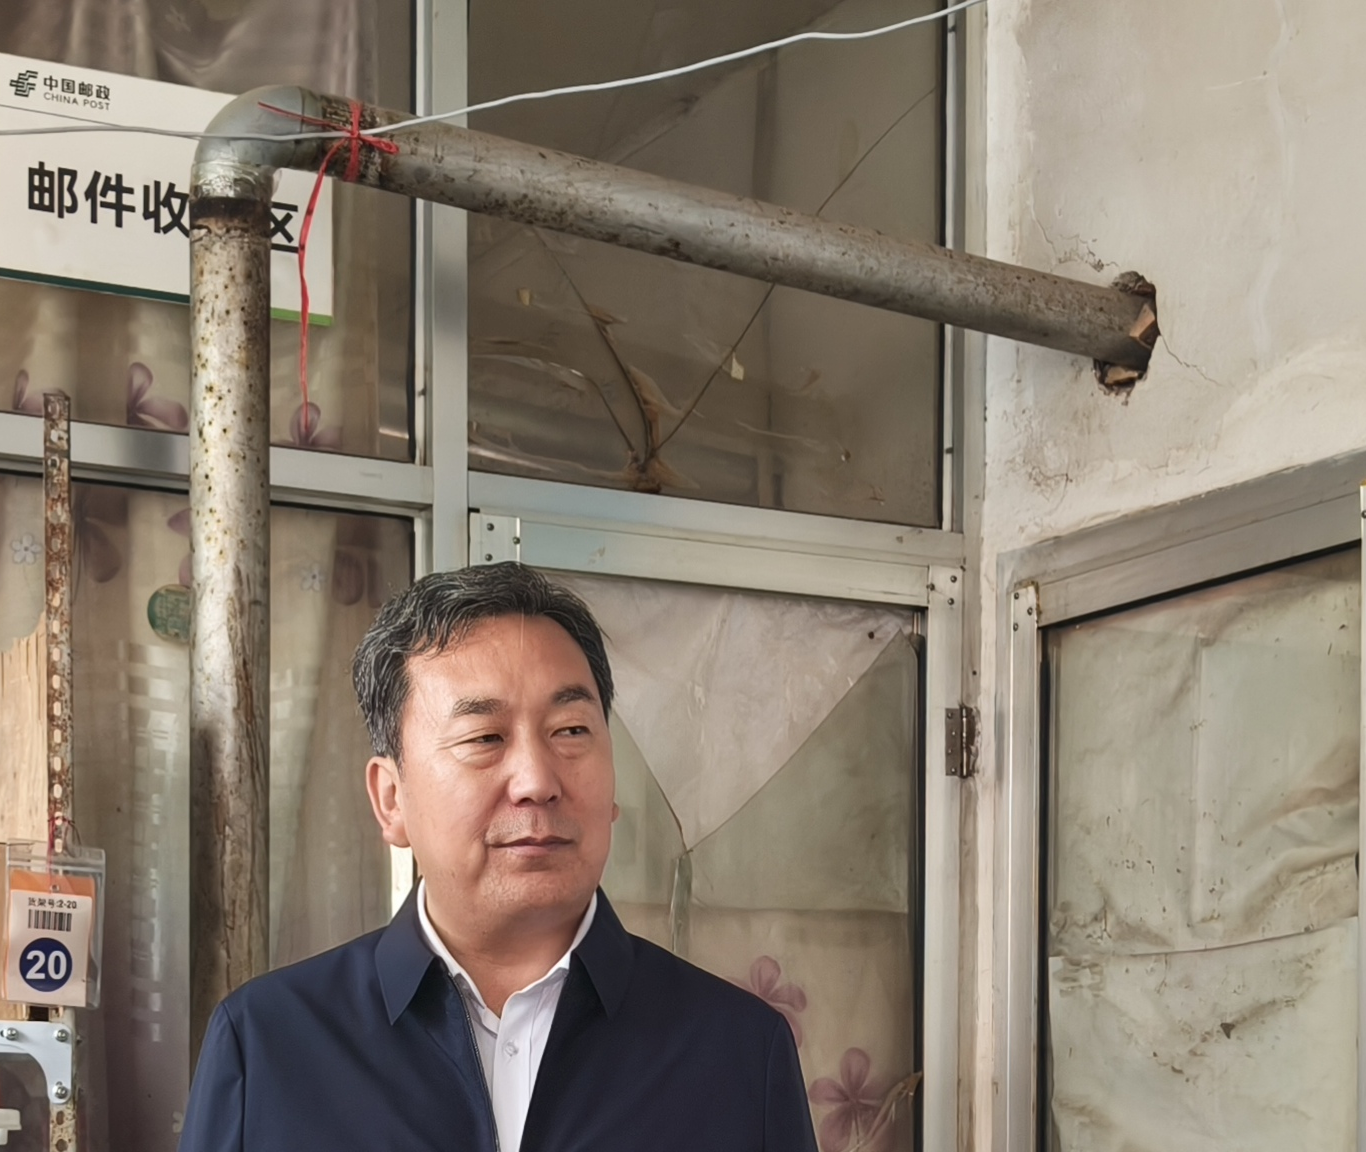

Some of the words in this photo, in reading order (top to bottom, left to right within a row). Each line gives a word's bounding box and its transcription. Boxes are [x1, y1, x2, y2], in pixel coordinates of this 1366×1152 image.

[43, 75, 111, 101] 中国邮政
[43, 92, 79, 106] CHINA
[82, 99, 110, 110] POST
[27, 161, 300, 255] 邮件收区
[25, 949, 67, 981] 20
